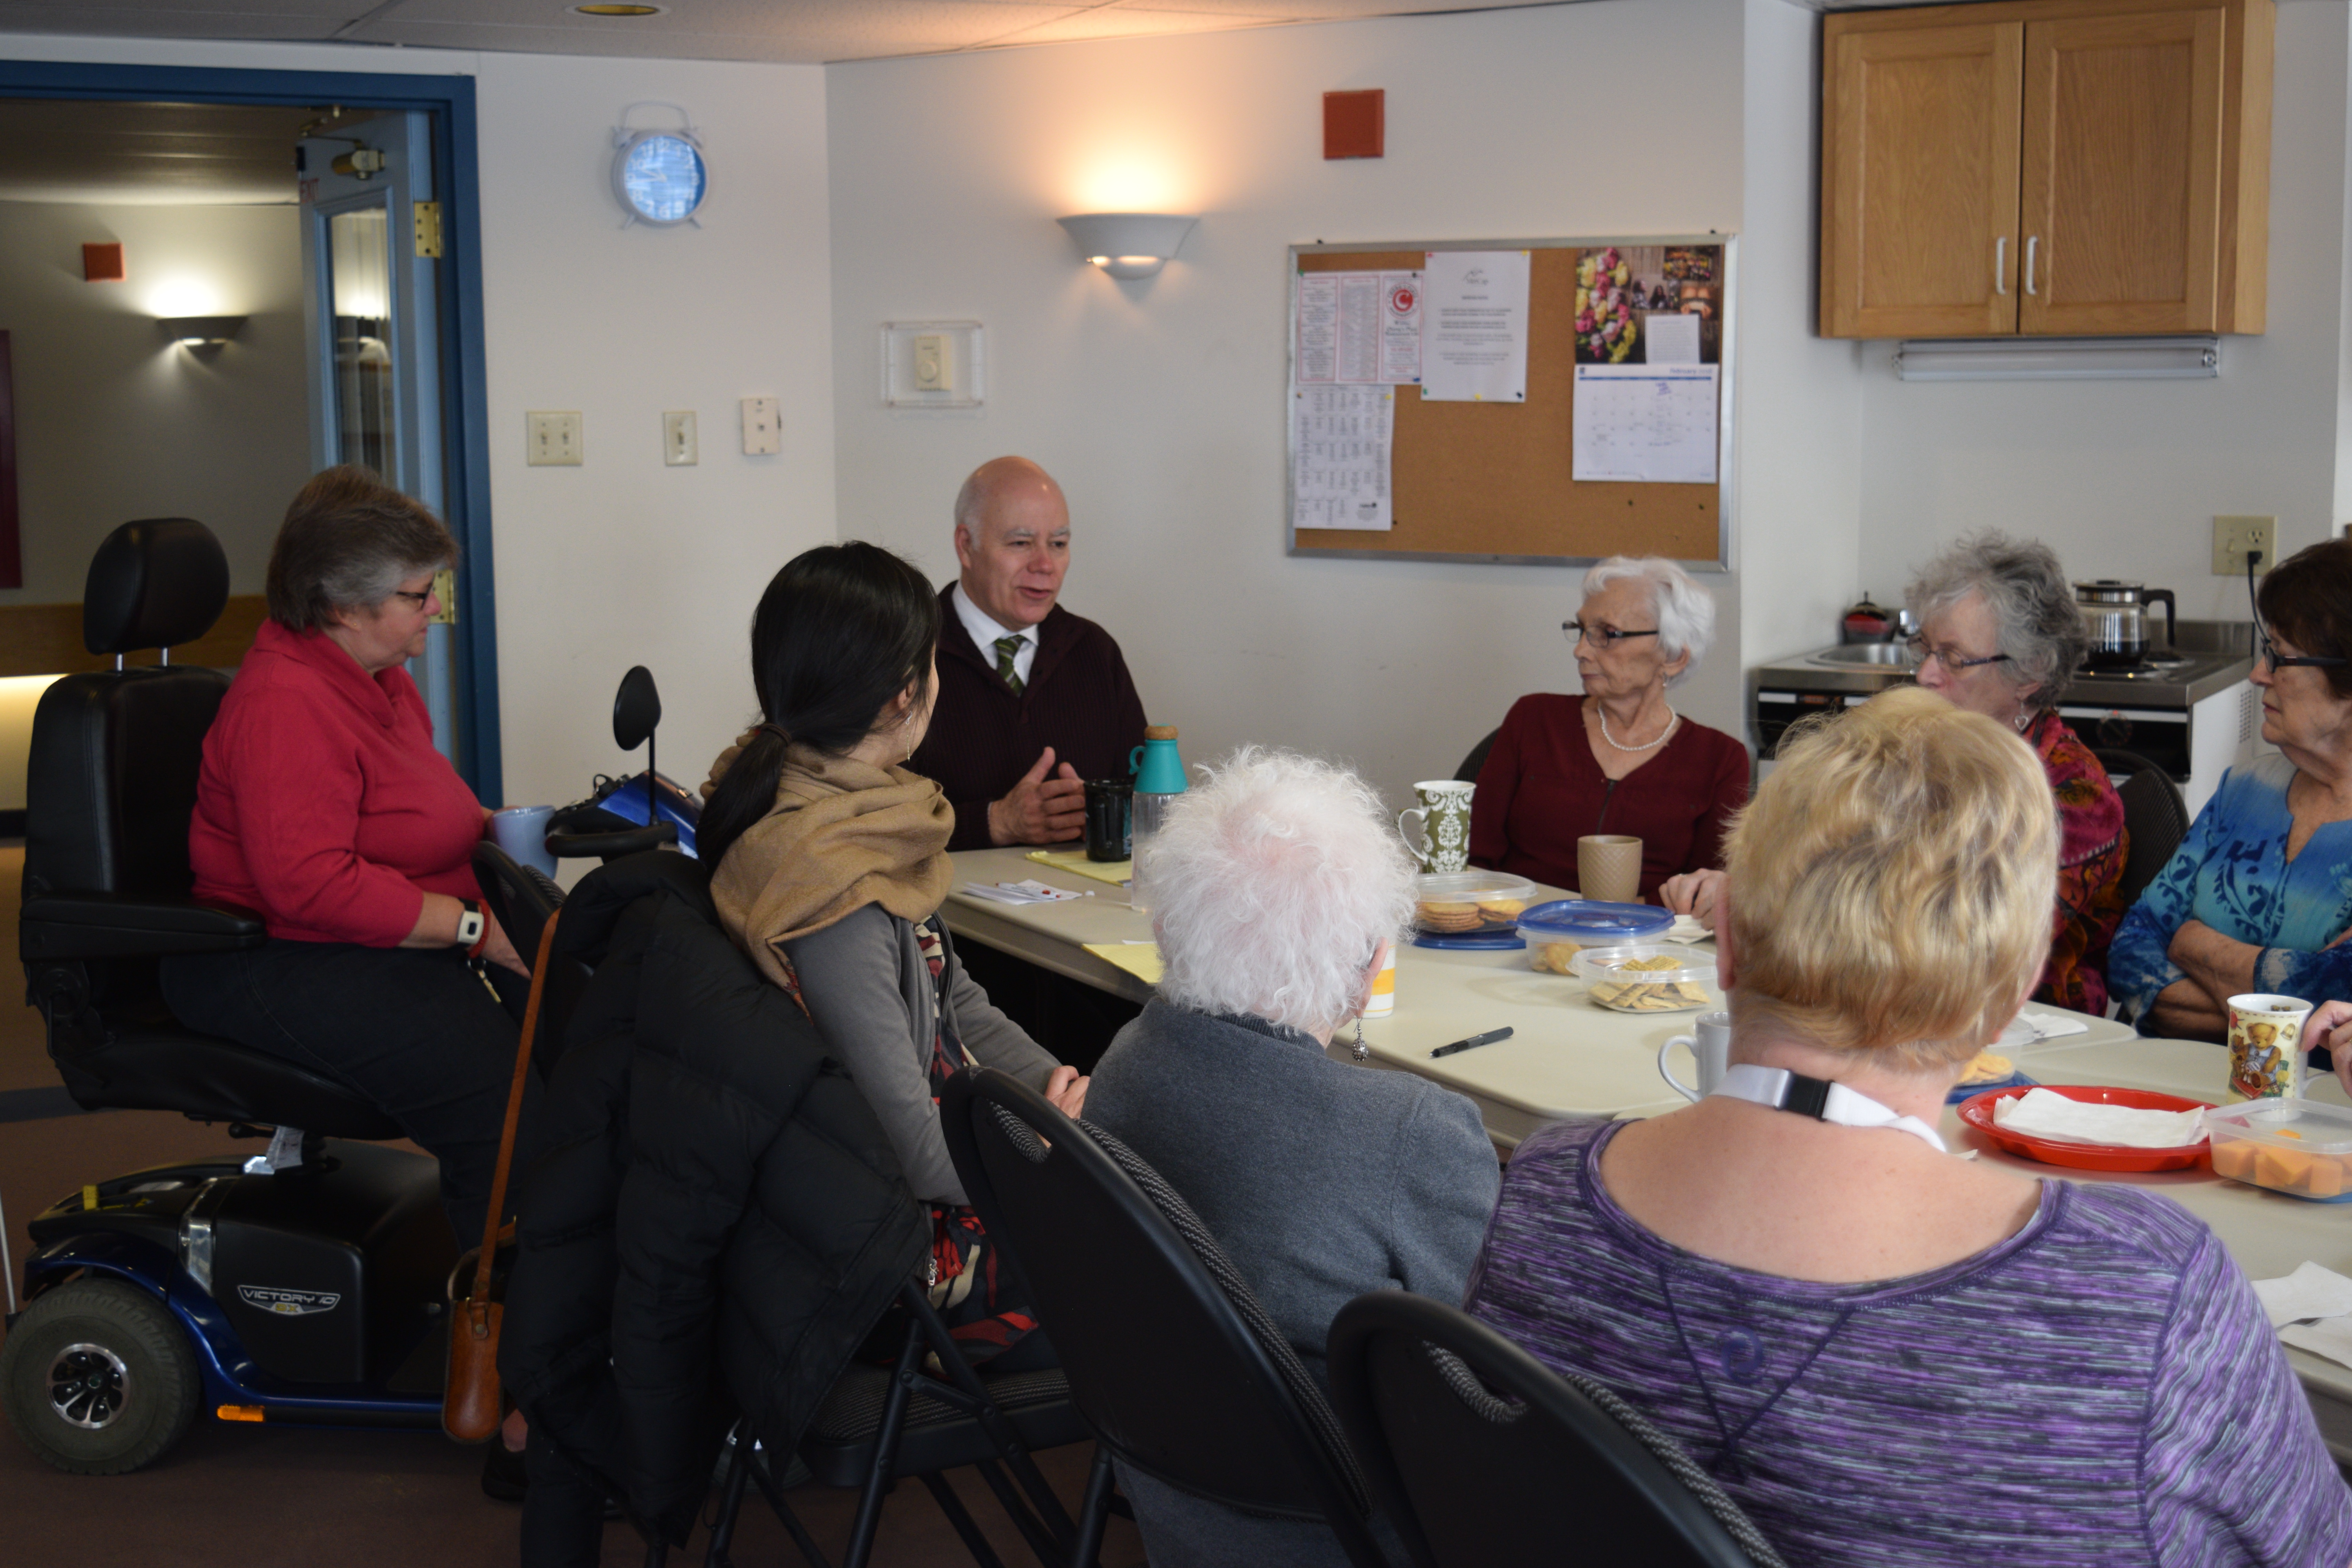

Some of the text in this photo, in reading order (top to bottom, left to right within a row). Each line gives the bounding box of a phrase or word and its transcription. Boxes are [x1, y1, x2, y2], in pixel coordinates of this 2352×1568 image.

[630, 158, 646, 171] 10
[300, 178, 319, 203] EXIT
[243, 1289, 315, 1303] VICTORY
